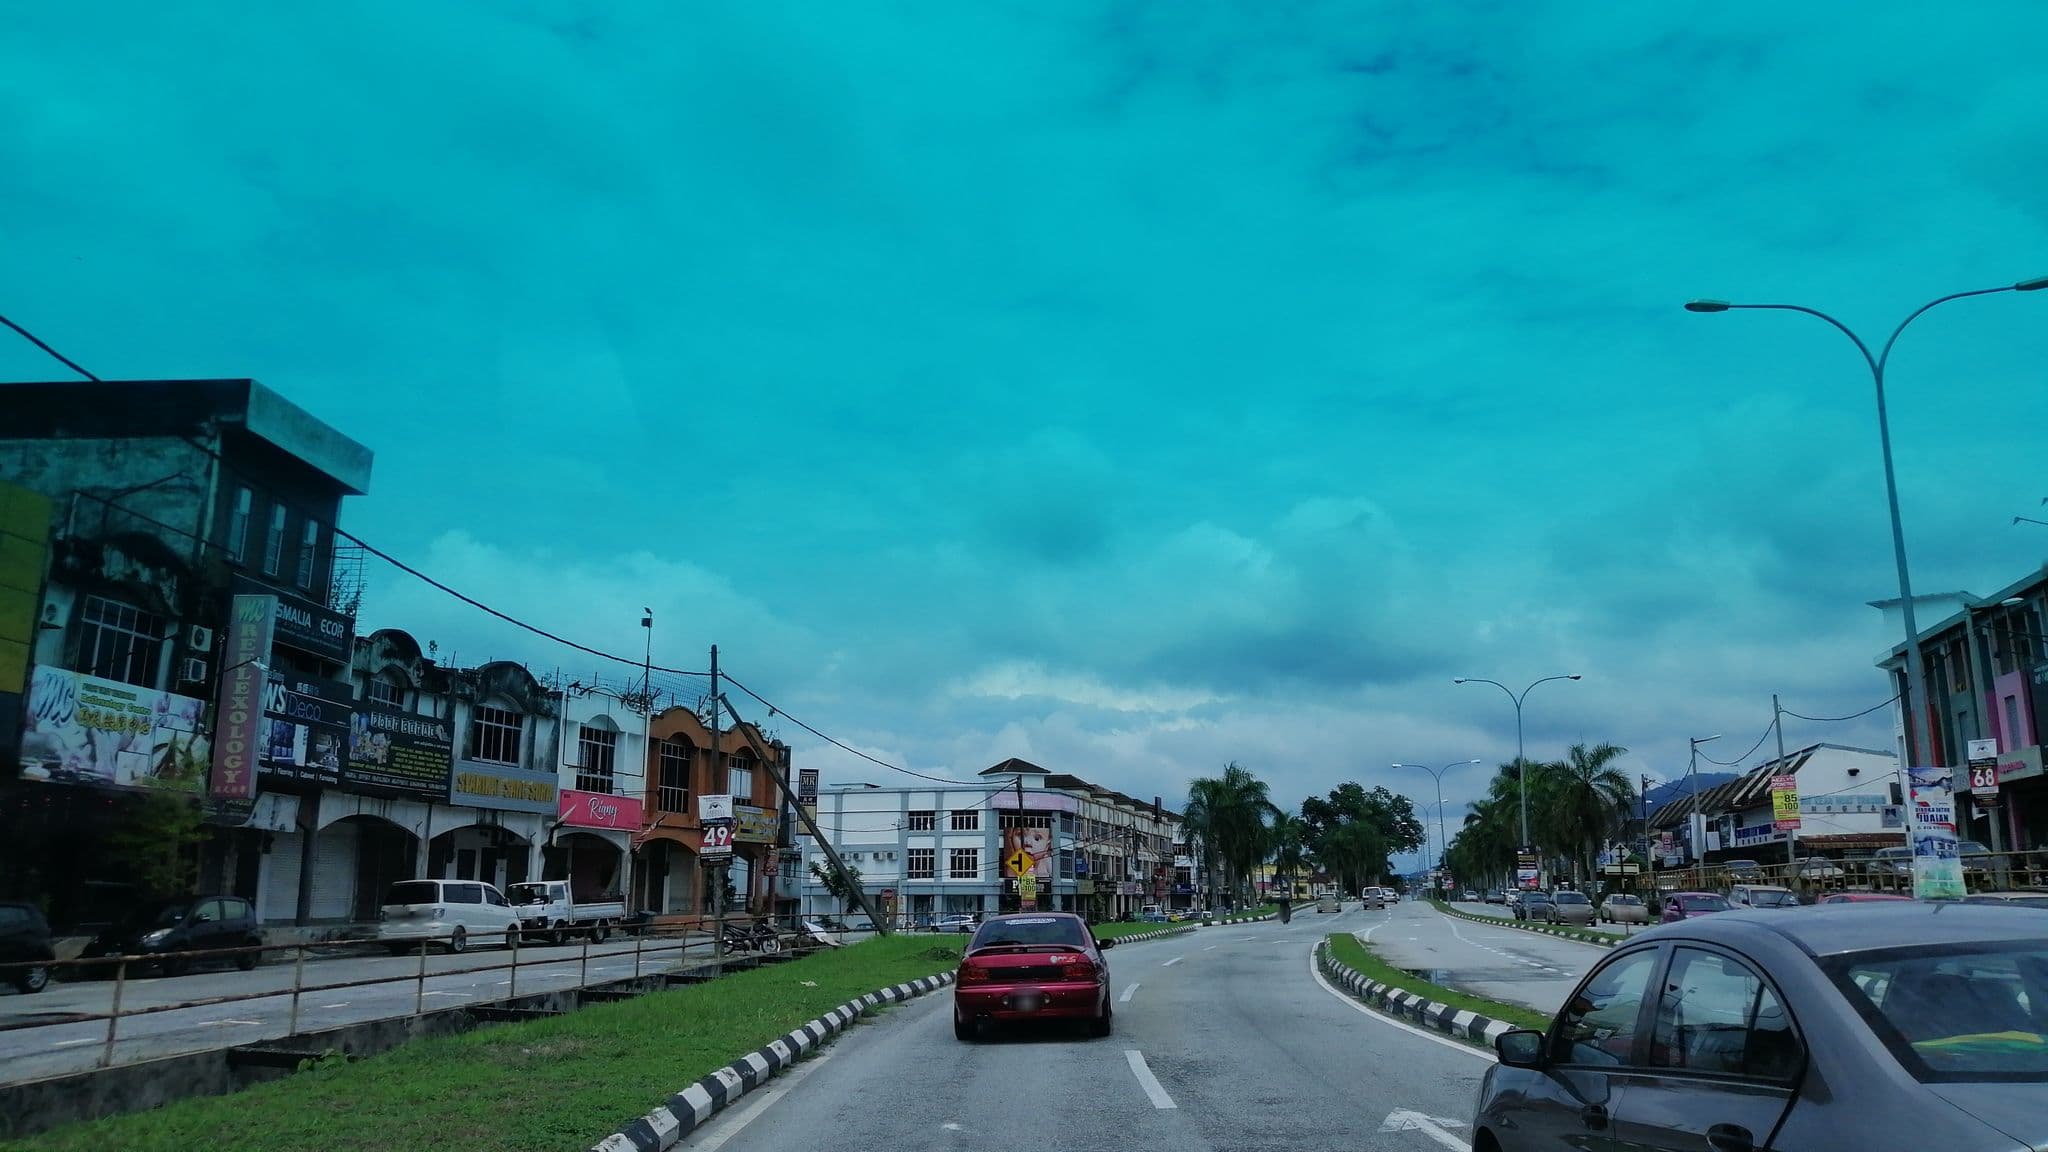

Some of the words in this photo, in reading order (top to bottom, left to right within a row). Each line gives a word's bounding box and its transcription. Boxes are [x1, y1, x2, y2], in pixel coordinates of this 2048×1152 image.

[287, 693, 322, 722] Deco
[1784, 793, 1798, 803] 85
[1784, 802, 1799, 810] 100
[703, 826, 729, 846] 49
